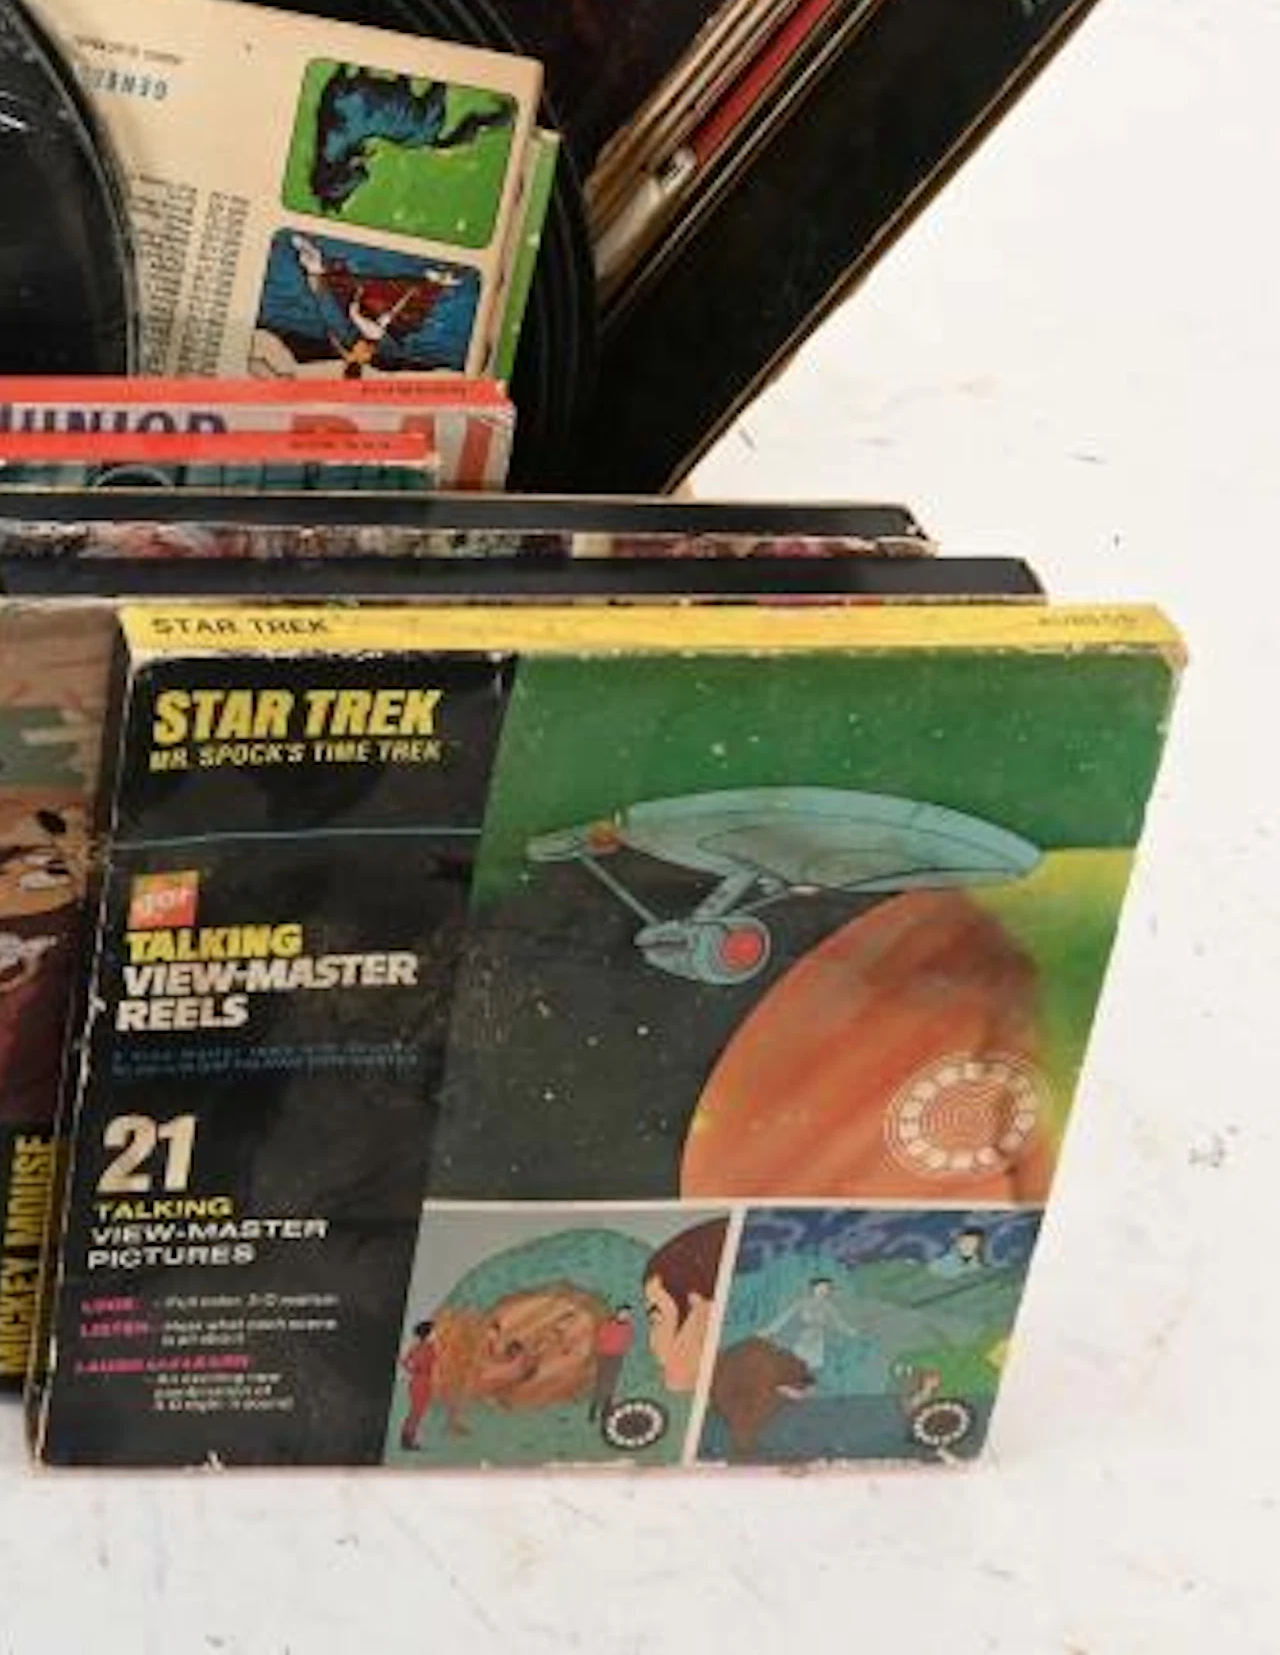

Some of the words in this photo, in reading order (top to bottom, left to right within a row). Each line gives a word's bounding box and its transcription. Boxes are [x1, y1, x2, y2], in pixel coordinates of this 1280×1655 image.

[151, 617, 237, 634] STAR
[247, 617, 329, 634] TREK
[153, 689, 295, 744] STAR
[304, 689, 443, 736] TREK
[199, 743, 306, 767] SPOCK'S
[312, 741, 369, 763] TIME
[375, 740, 442, 763] TREK
[125, 923, 303, 963] TALKING
[122, 951, 418, 997] VIEW-MASTER
[114, 994, 249, 1031] REELS
[96, 1114, 196, 1193] 21
[3, 1134, 56, 1247] MOUSE
[93, 1197, 234, 1222] TALKING
[90, 1219, 332, 1246] VIEW-MASTER
[87, 1243, 258, 1271] PICTURES
